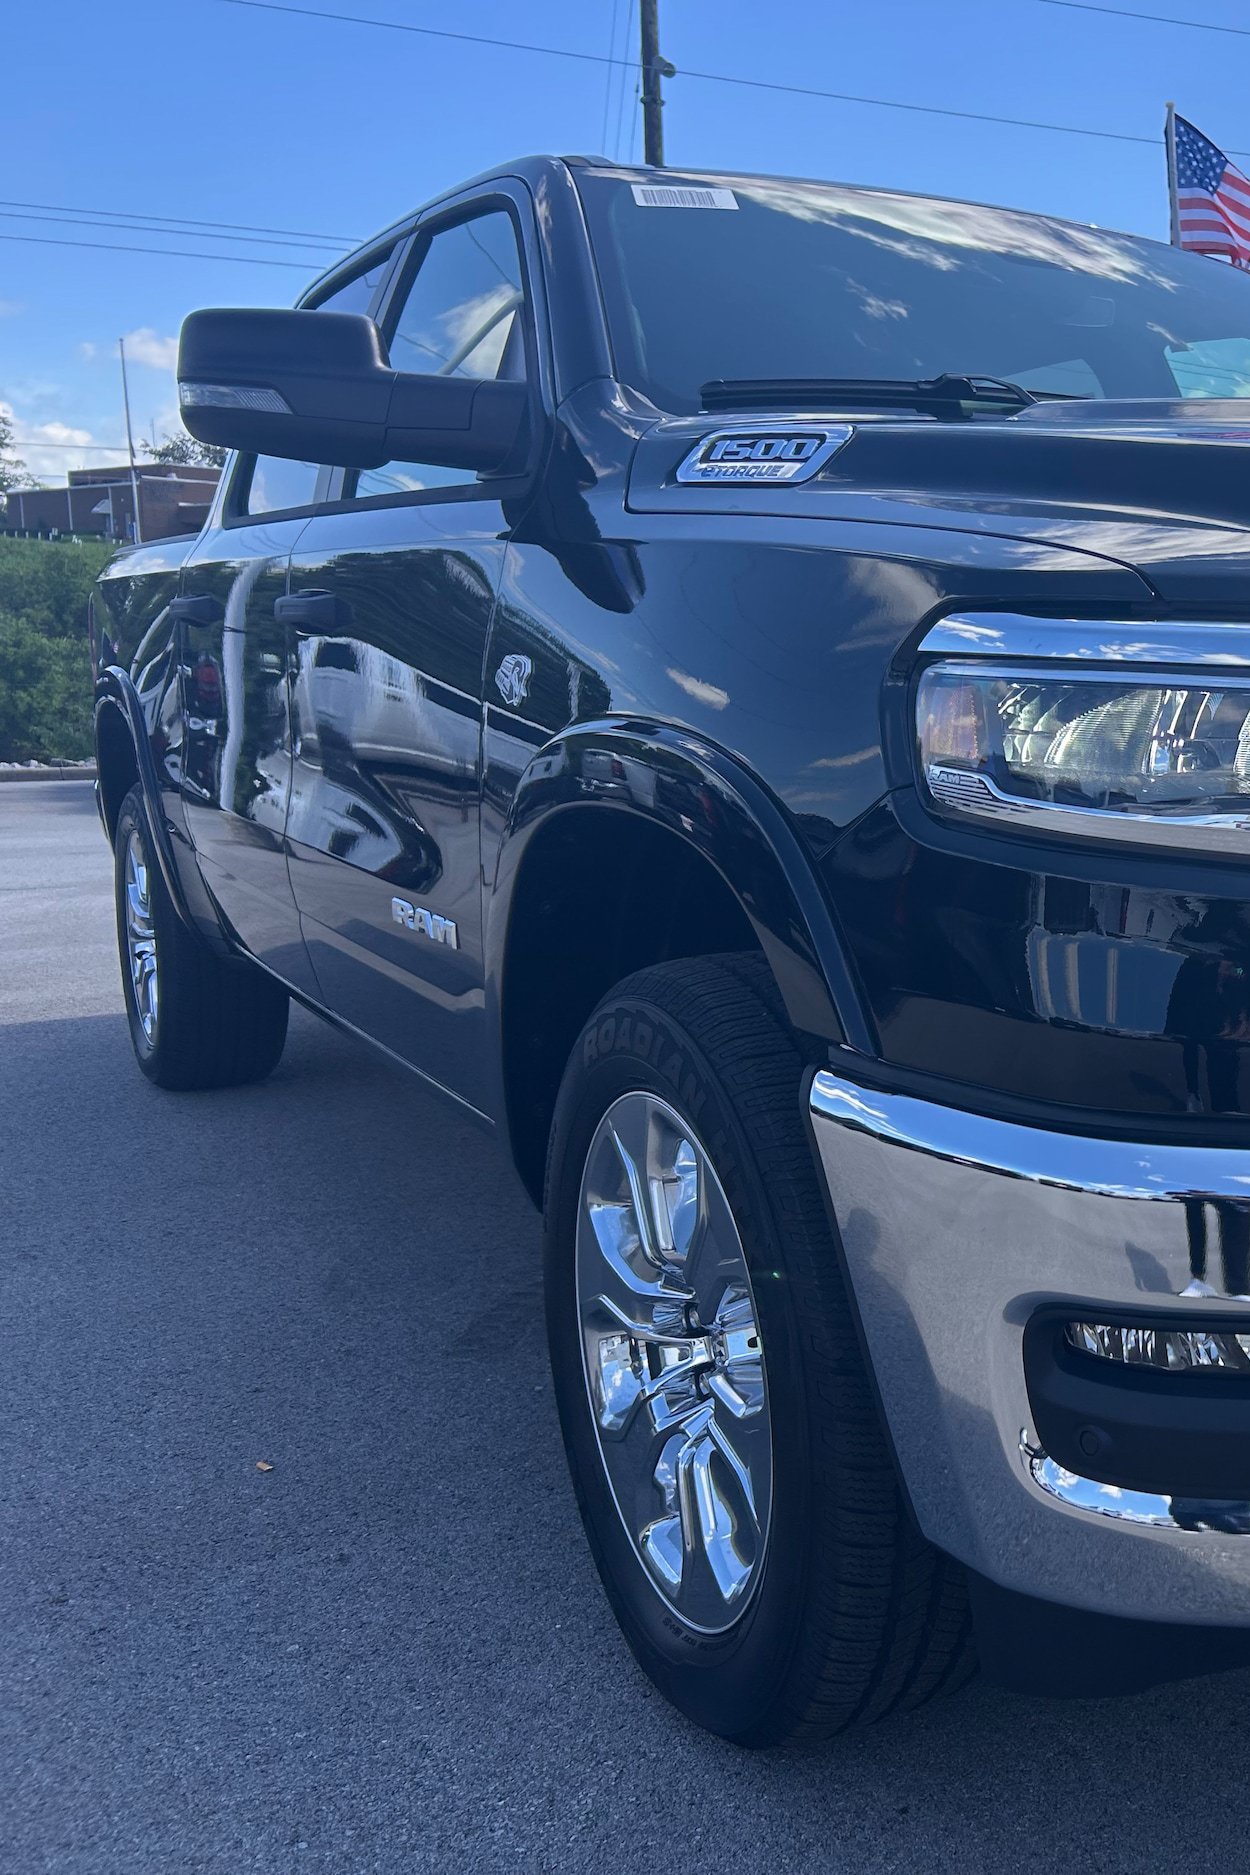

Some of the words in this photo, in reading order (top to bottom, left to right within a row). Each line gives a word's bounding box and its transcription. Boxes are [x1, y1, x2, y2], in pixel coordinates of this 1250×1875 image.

[709, 438, 821, 461] 1500
[391, 896, 459, 950] RAM
[582, 1015, 707, 1122] ROADIAN
